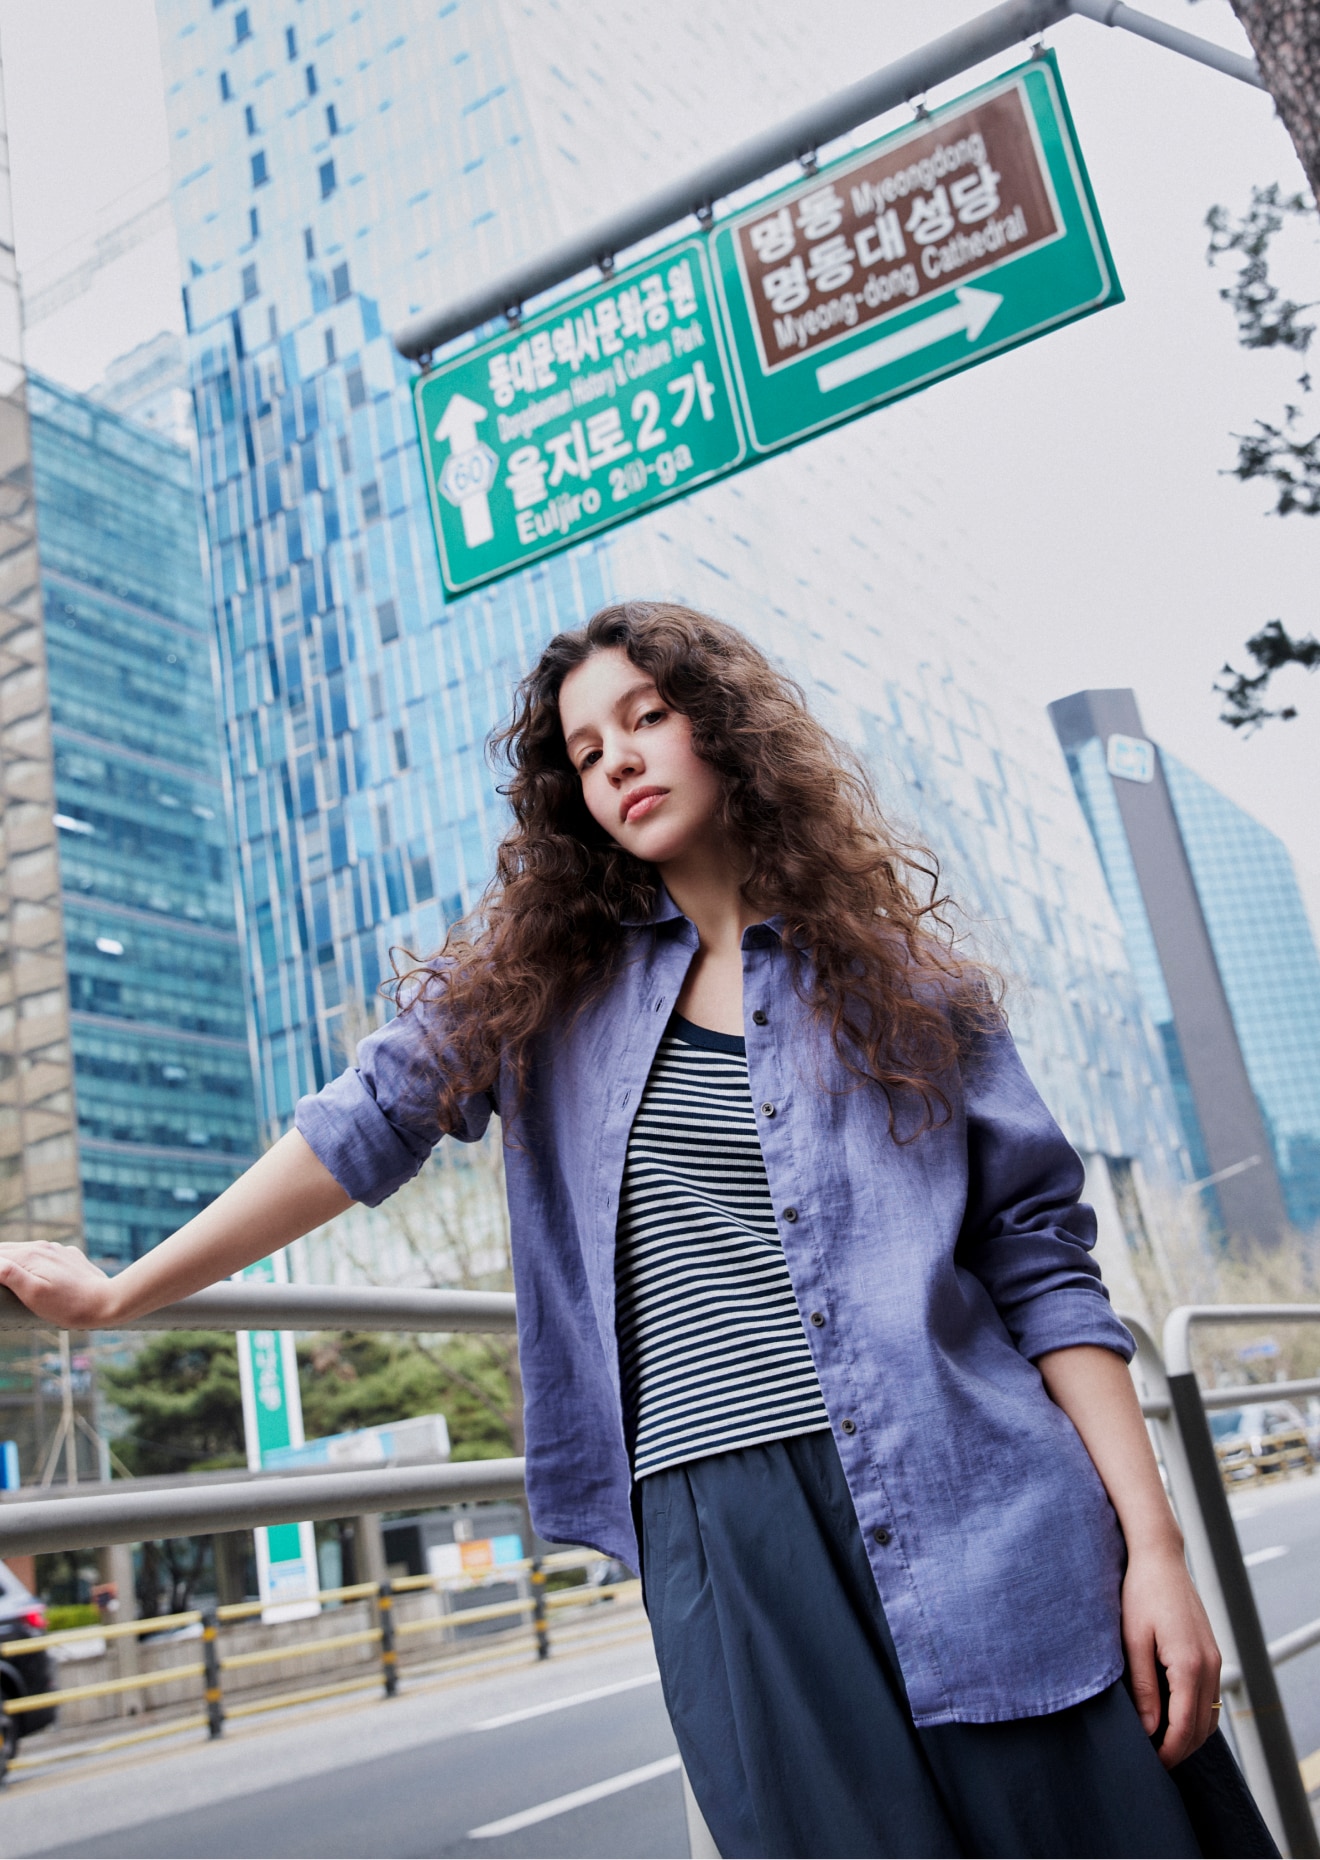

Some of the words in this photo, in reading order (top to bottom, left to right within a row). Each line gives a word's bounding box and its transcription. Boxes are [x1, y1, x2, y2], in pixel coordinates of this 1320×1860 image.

[750, 184, 844, 264] 명동
[849, 132, 987, 216] Myeongdong
[762, 163, 1001, 313] 명동대성당
[488, 258, 698, 407] 동대문역사문화공원
[772, 264, 919, 350] Myeong-dong
[920, 204, 1028, 279] Cathedral
[570, 367, 616, 407] History
[613, 356, 628, 386] &
[624, 340, 672, 379] Culture
[671, 318, 706, 357] Park
[454, 455, 484, 490] 60
[515, 487, 602, 545] Euljiro
